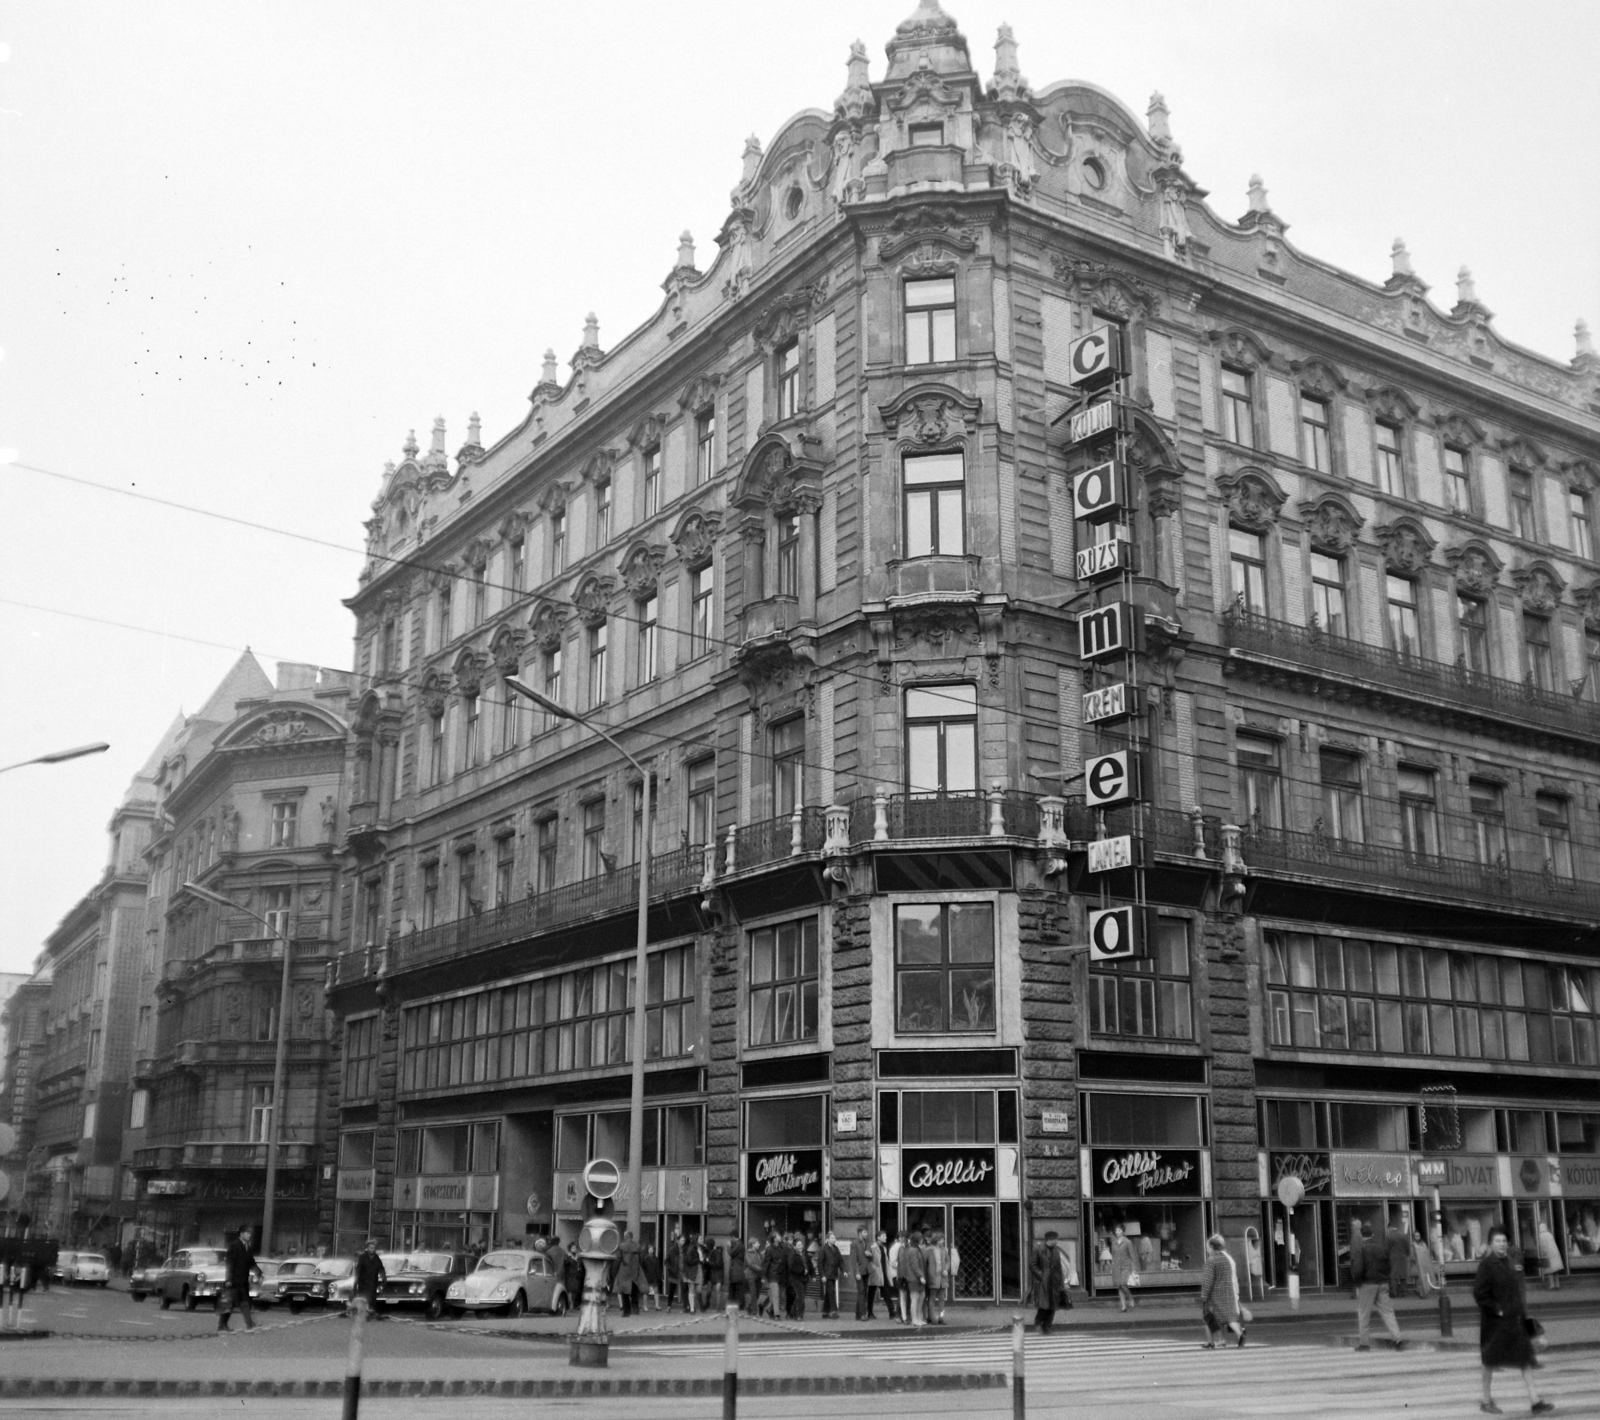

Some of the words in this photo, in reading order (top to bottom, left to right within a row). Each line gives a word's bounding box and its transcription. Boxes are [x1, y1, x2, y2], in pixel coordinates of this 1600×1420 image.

[1083, 685, 1124, 722] KRÉM
[909, 1159, 994, 1188] Csillár
[1454, 1166, 1494, 1185] DIVAT
